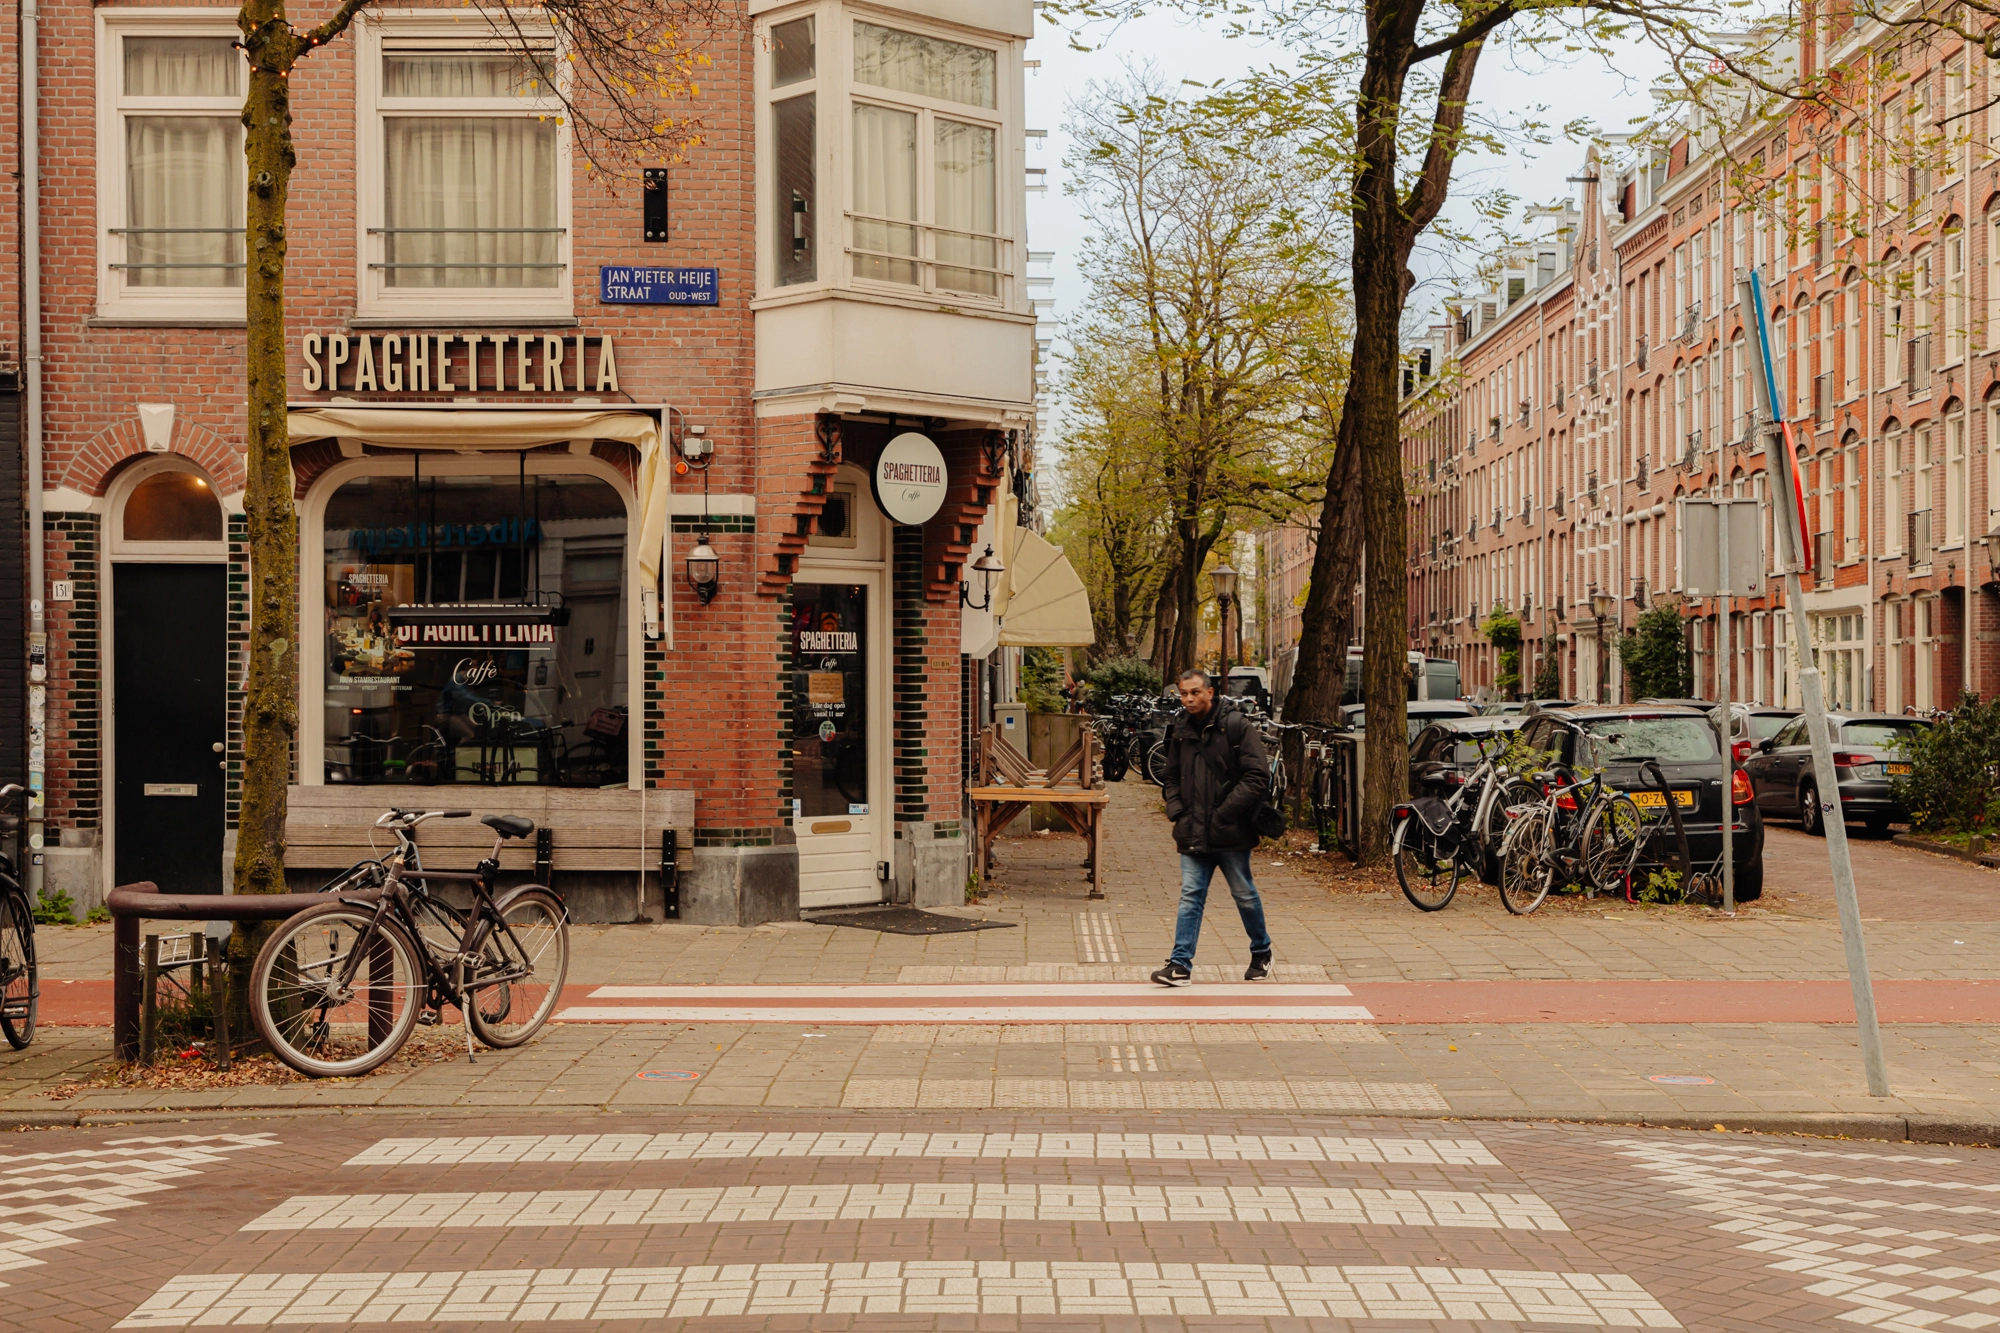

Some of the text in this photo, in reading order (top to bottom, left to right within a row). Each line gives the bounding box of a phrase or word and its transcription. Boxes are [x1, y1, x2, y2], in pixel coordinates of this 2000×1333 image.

[607, 270, 711, 288] JAN PIETER HEIJE
[607, 286, 711, 301] STRAAT OUD-WEST
[302, 333, 619, 392] SPAGHETTERIA
[883, 461, 940, 484] SPAGHETTERIA
[348, 573, 389, 584] SPAGHETTERIA
[800, 631, 858, 650] SPAGHETTERIA
[452, 657, 498, 686] Caffè
